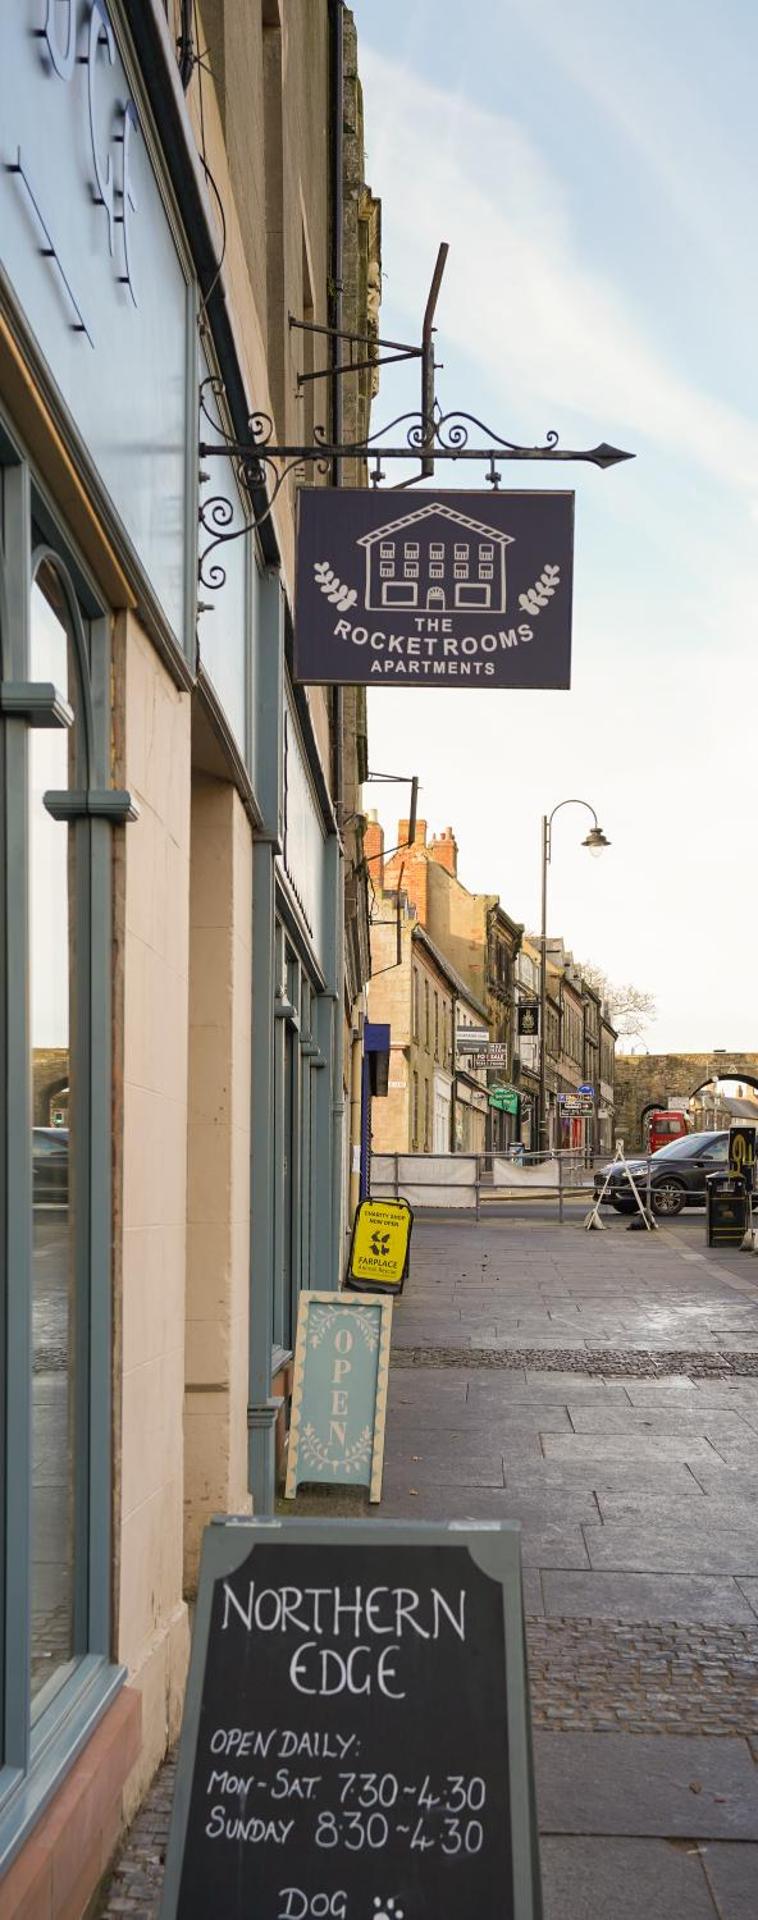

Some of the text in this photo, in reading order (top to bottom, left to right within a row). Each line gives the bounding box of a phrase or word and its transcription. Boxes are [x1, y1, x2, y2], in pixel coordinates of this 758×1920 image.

[414, 617, 453, 633] THE
[370, 659, 496, 676] APARTMENTS
[358, 1256, 398, 1270] FARPLACE
[328, 1328, 353, 1447] OPEN
[221, 1581, 467, 1640] NORTHERN
[289, 1641, 406, 1699] EDGE
[210, 1728, 277, 1758] OPEN
[205, 1805, 295, 1844] SUNDAY
[278, 1887, 348, 1920] DOG
